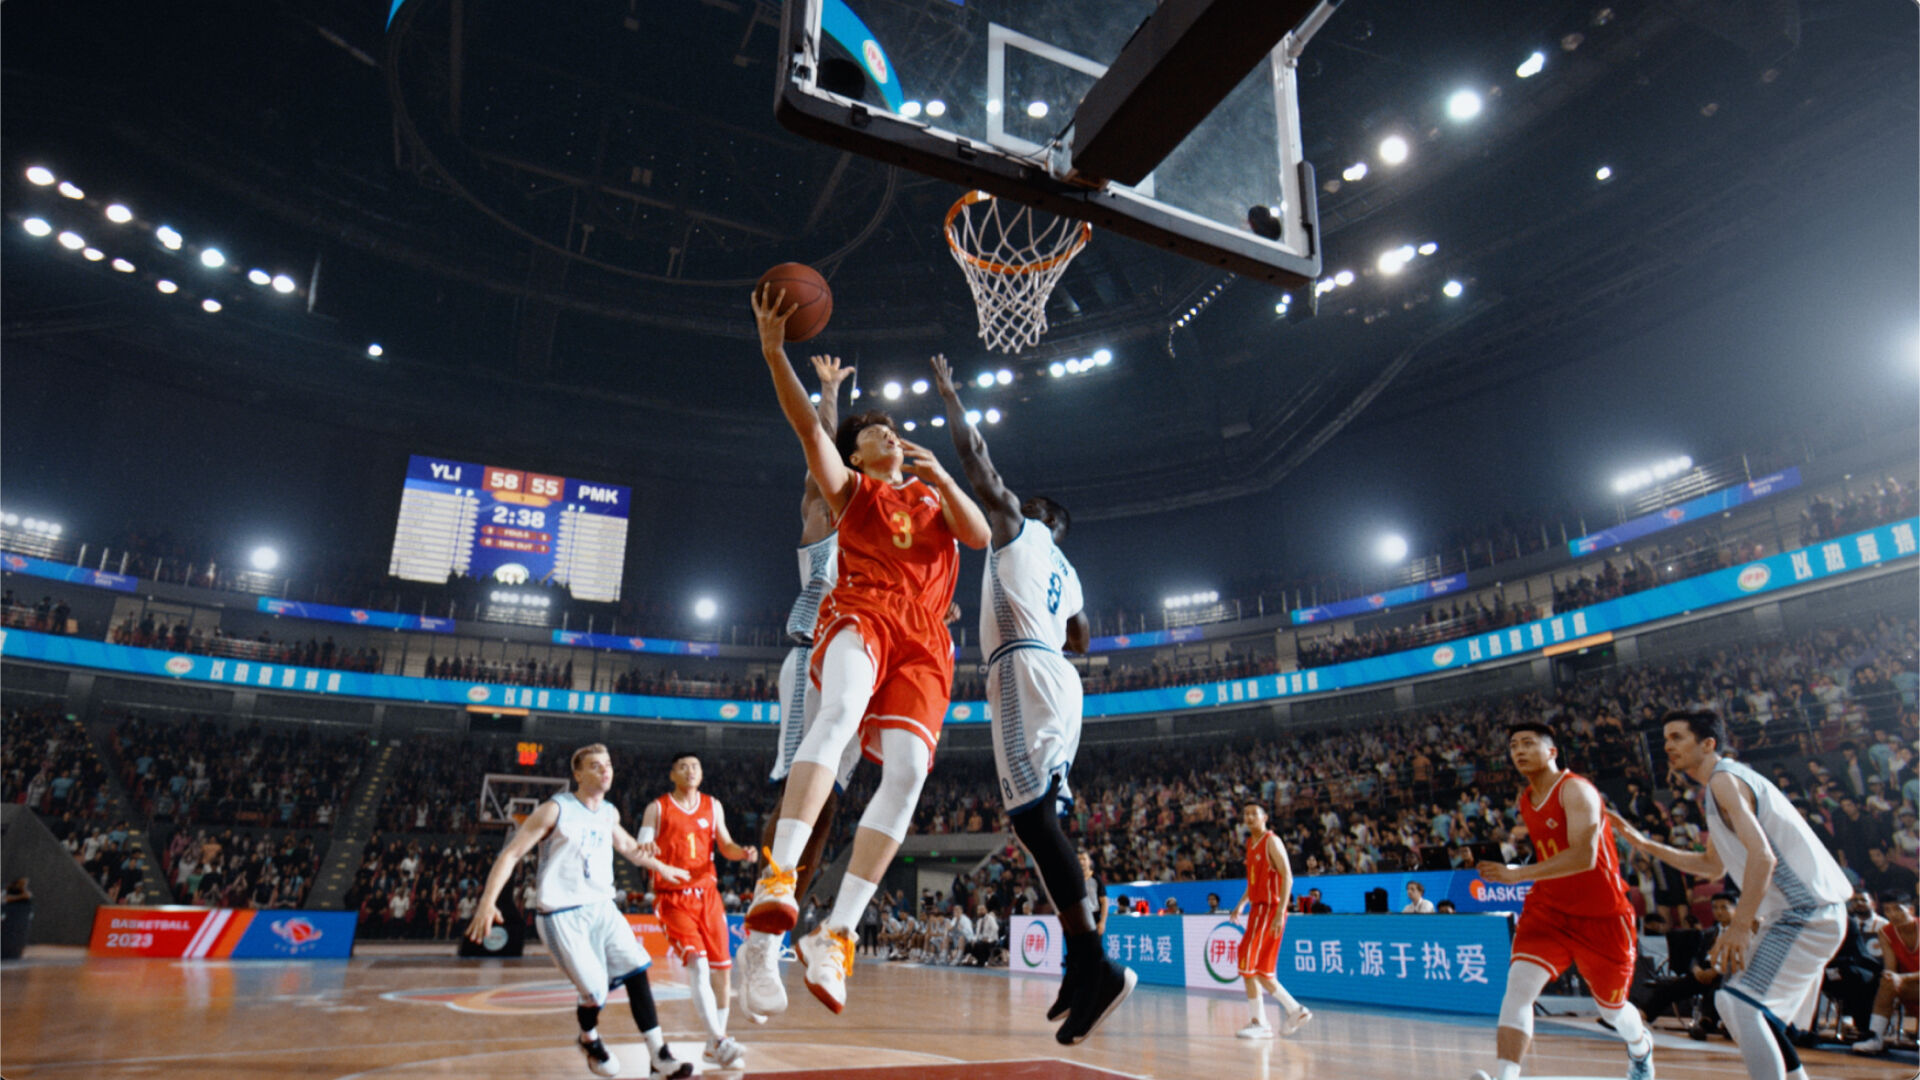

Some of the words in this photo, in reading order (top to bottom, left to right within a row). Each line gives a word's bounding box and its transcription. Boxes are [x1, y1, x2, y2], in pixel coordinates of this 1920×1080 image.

[430, 462, 461, 482] YLI
[490, 471, 519, 490] 58
[530, 477, 559, 496] 55
[578, 484, 618, 505] PMK
[492, 505, 546, 529] 2:38
[892, 510, 913, 550] 3
[1047, 571, 1063, 616] 8
[1002, 777, 1014, 800] 8
[686, 831, 696, 859] 1
[110, 918, 191, 931] BASKETBALL
[106, 933, 154, 948] 2023
[1025, 934, 1046, 953] 伊利
[1107, 933, 1173, 964] 源于热爱
[1294, 939, 1489, 984] 品质,源于热爱
